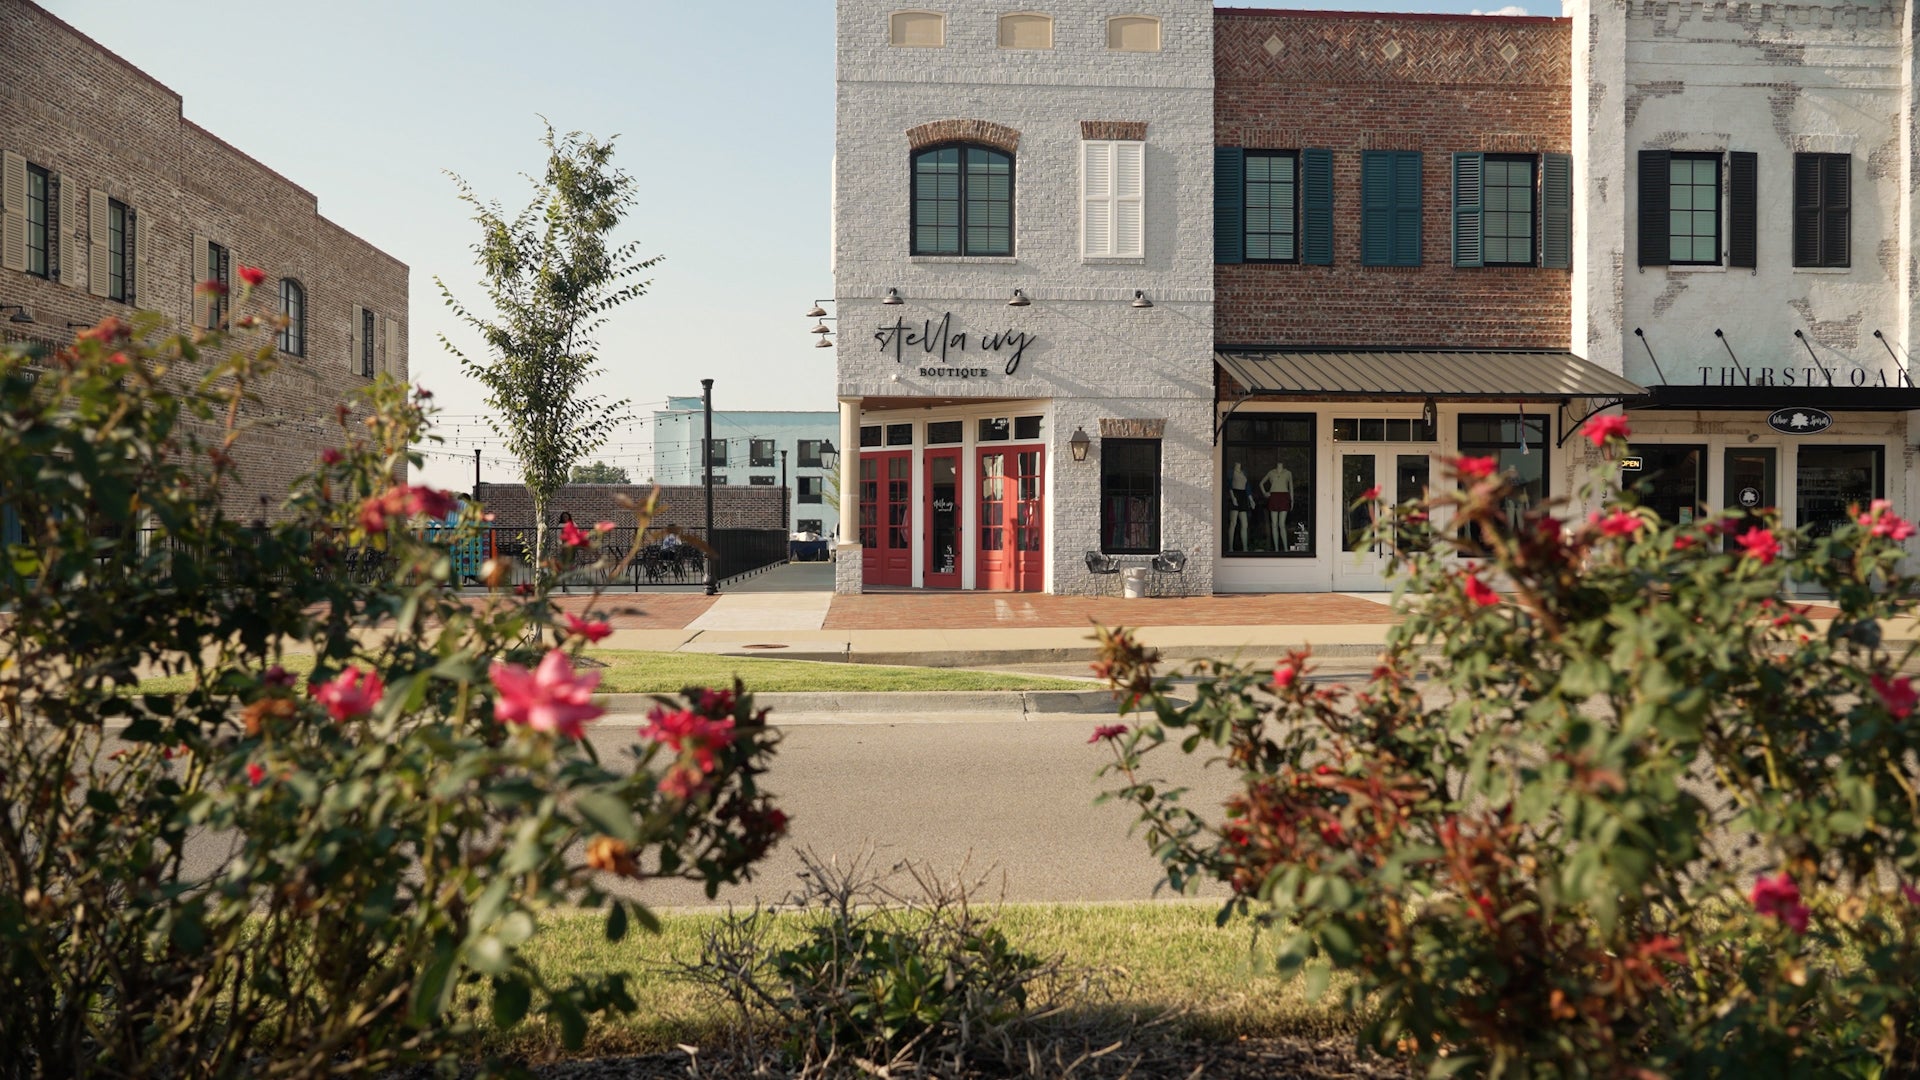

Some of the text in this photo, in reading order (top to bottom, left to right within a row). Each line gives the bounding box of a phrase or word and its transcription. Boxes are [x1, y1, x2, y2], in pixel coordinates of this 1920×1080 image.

[874, 311, 1037, 375] stella ivy
[919, 367, 989, 379] BOUTIQUE
[1698, 366, 1911, 388] THIRSTY OAK
[1621, 460, 1640, 468] OPEN
